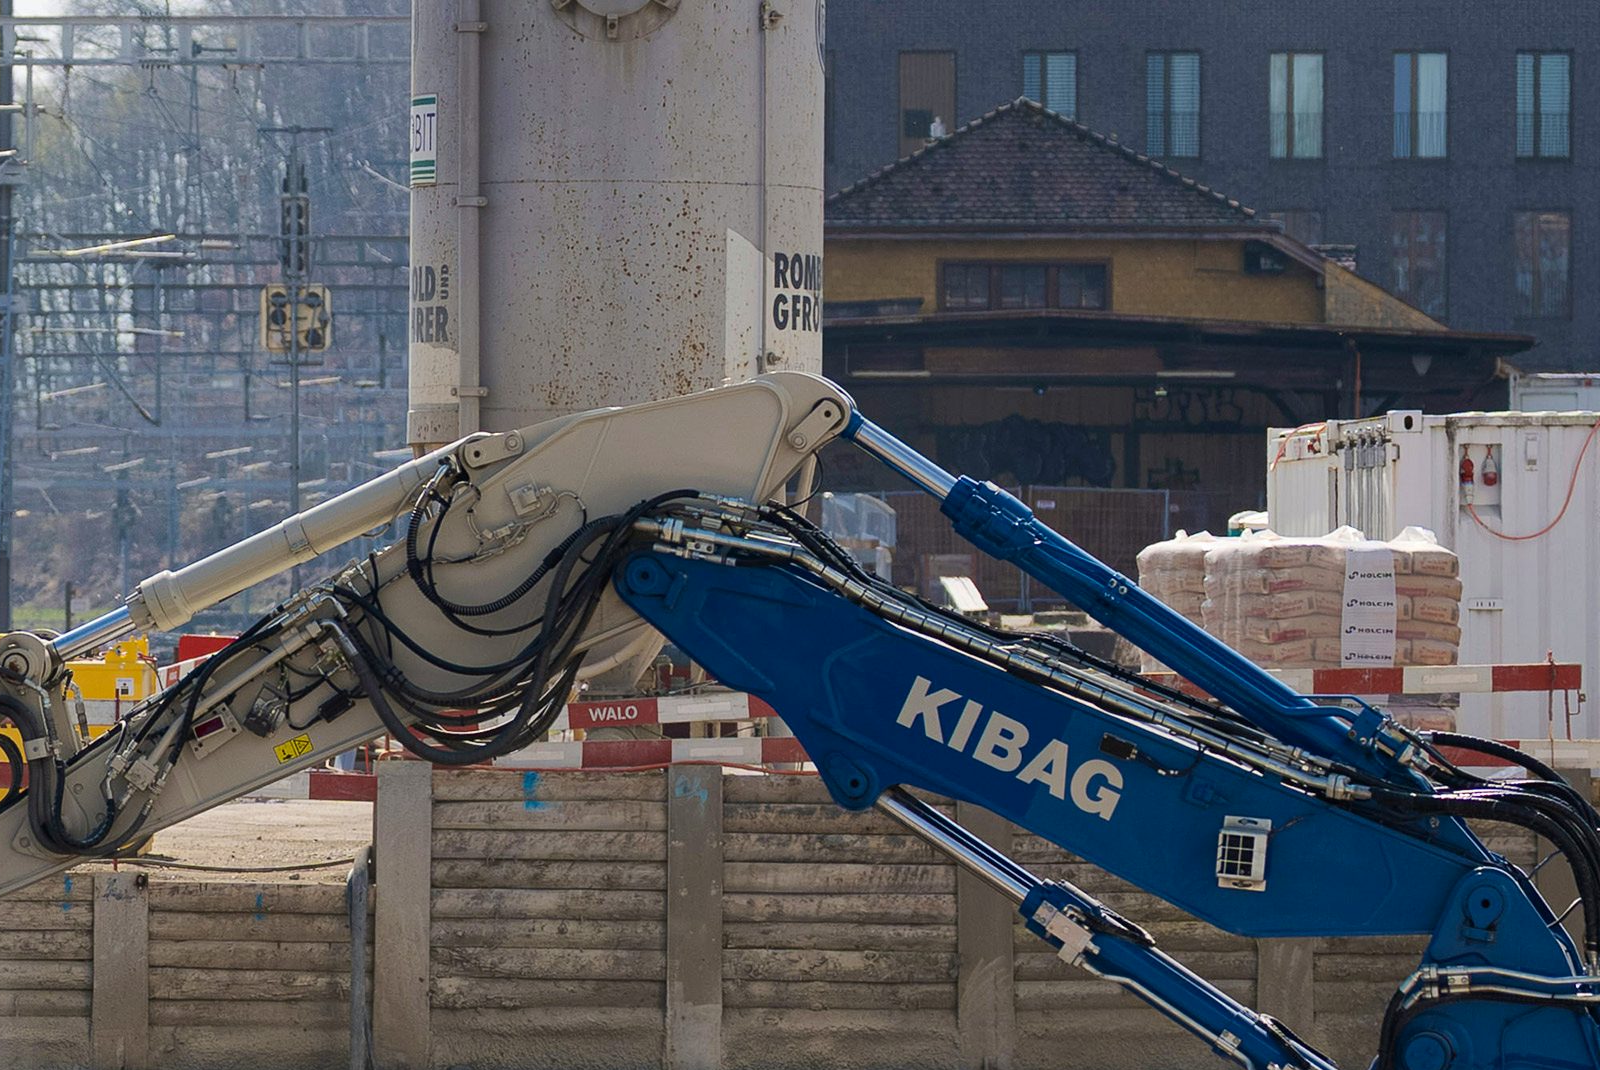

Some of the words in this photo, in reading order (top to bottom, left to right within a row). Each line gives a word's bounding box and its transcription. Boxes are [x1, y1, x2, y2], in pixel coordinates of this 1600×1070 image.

[440, 262, 450, 300] UND
[1357, 653, 1392, 661] HOLCIM
[588, 705, 639, 723] WALO
[895, 674, 1125, 822] KIBAG
